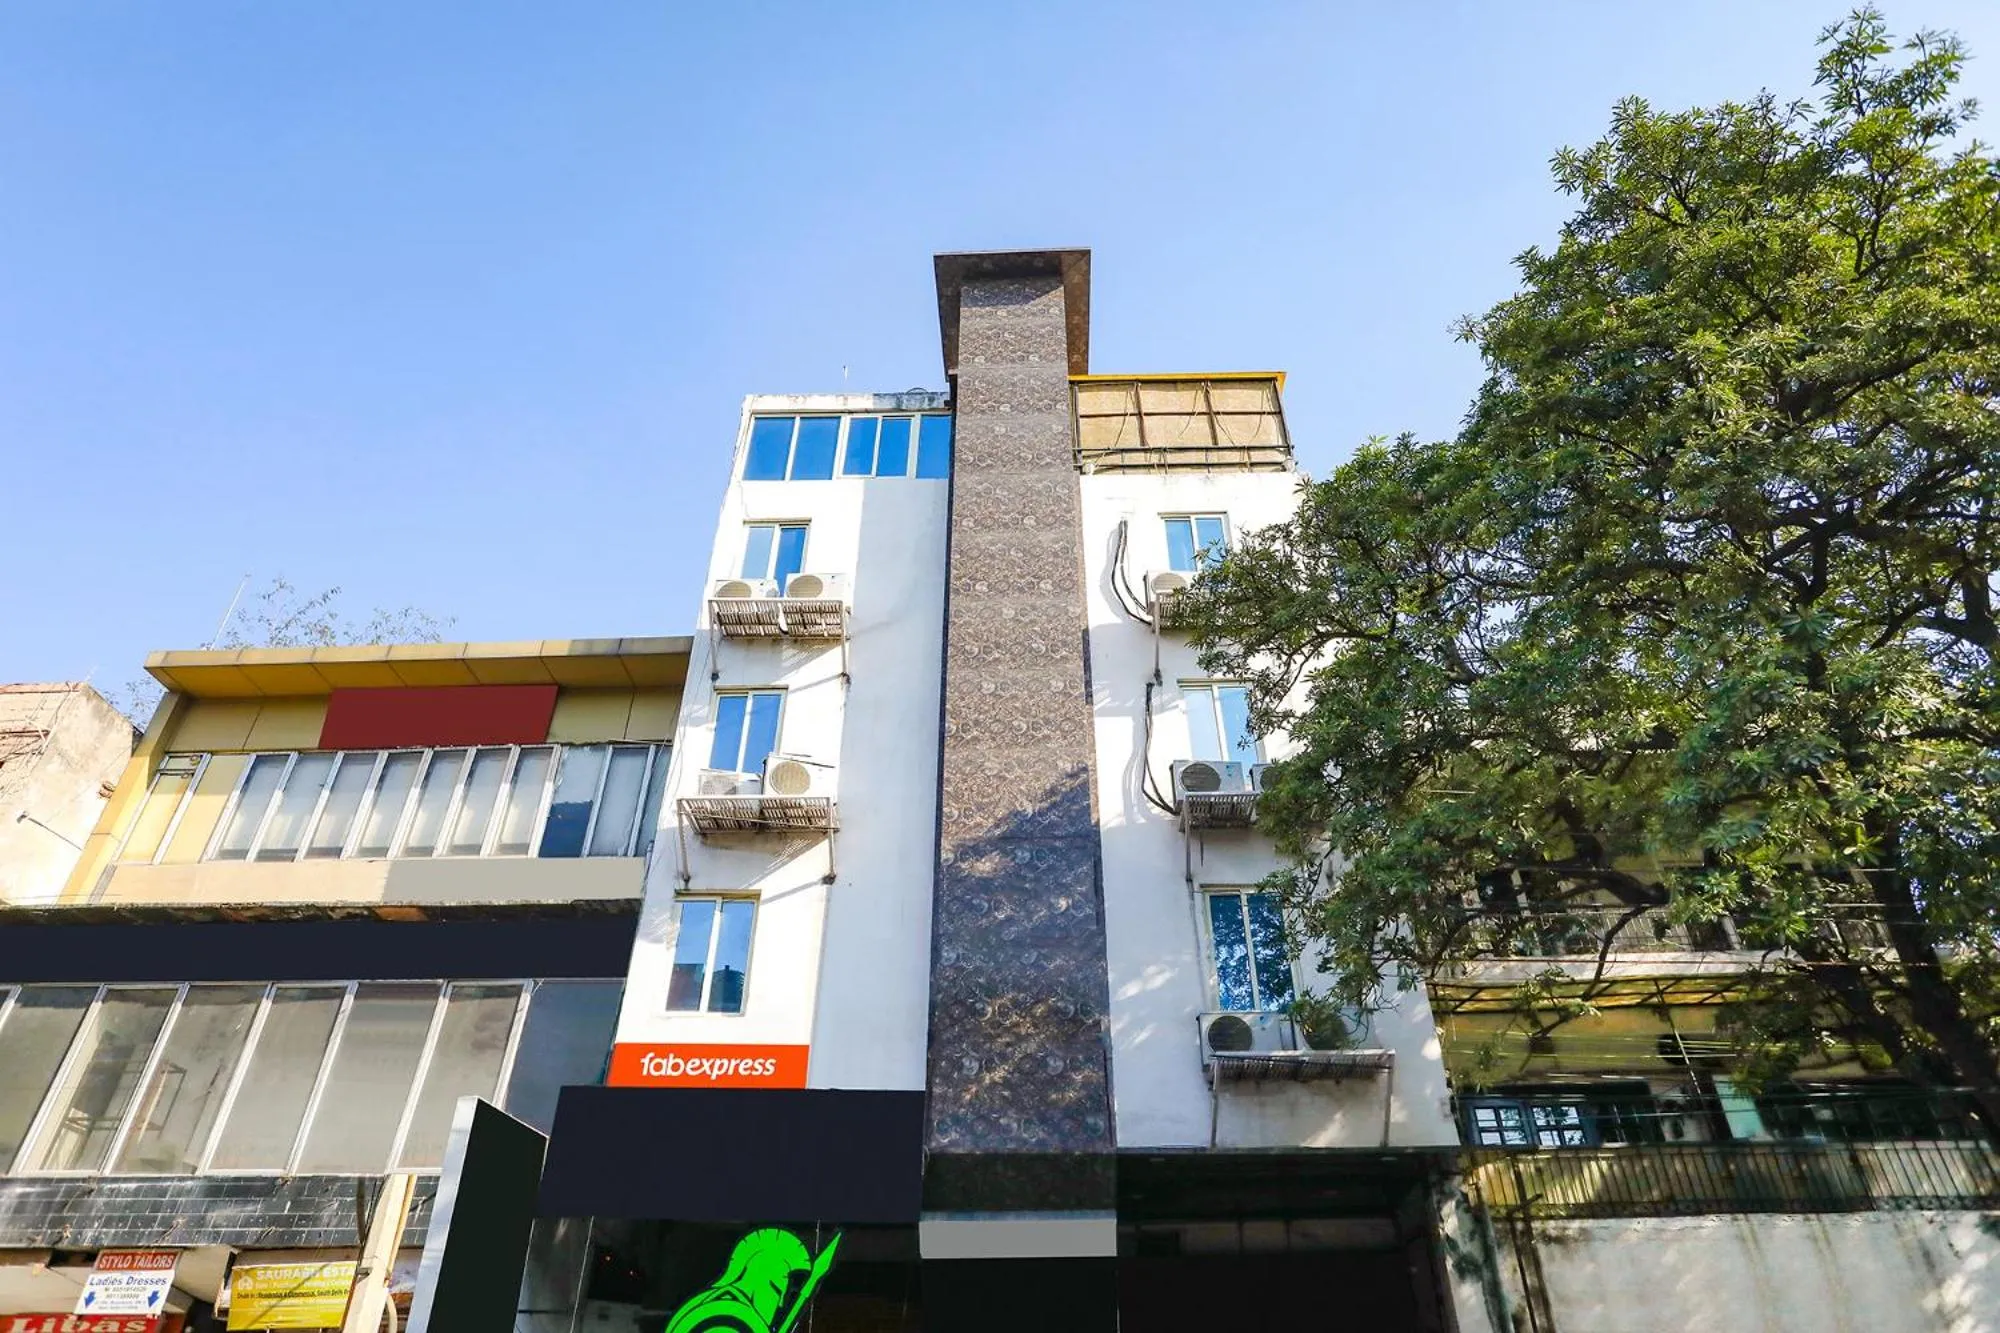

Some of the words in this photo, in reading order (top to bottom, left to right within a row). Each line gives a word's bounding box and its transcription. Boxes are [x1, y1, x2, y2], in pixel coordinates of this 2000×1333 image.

[640, 1052, 777, 1080] fabexpress
[99, 1255, 131, 1269] STYLO
[133, 1254, 174, 1268] TAILORS
[89, 1276, 123, 1286] Ladies
[126, 1276, 167, 1286] Dresses
[8, 1314, 147, 1333] Libas
